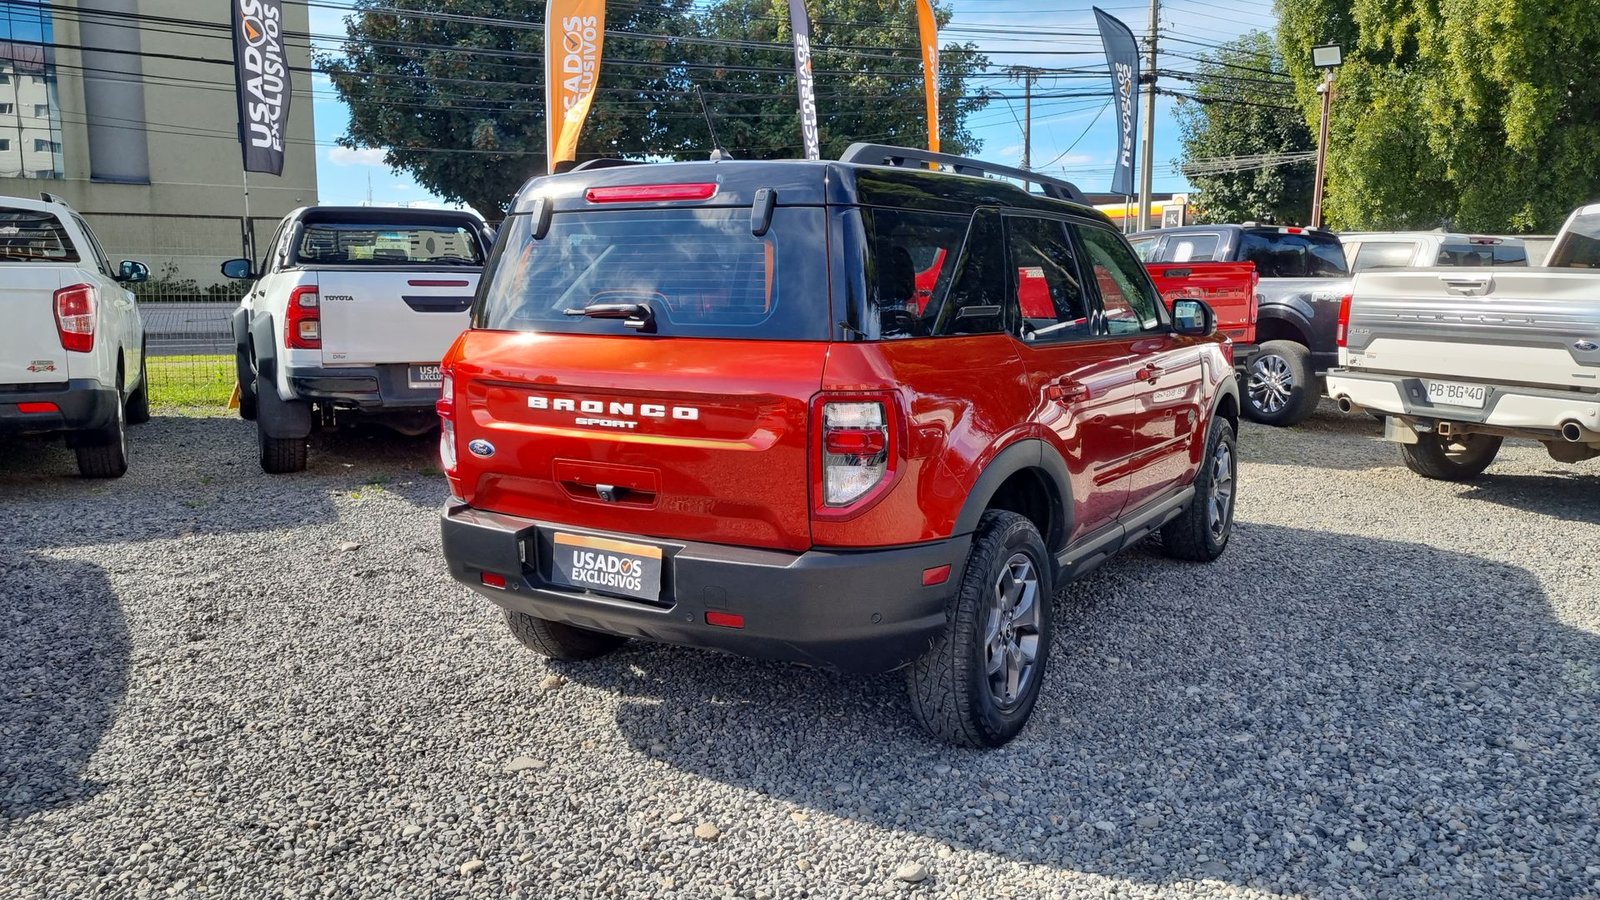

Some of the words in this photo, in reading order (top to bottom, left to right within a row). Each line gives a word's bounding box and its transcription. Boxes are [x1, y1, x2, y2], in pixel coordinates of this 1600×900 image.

[240, 0, 272, 148] USADOS
[563, 16, 583, 119] SADOS
[420, 366, 440, 375] USA
[527, 396, 699, 420] BRONCO
[575, 417, 638, 429] SPORT
[573, 550, 642, 577] USADOS
[571, 567, 641, 591] EXCLUSIVOS
